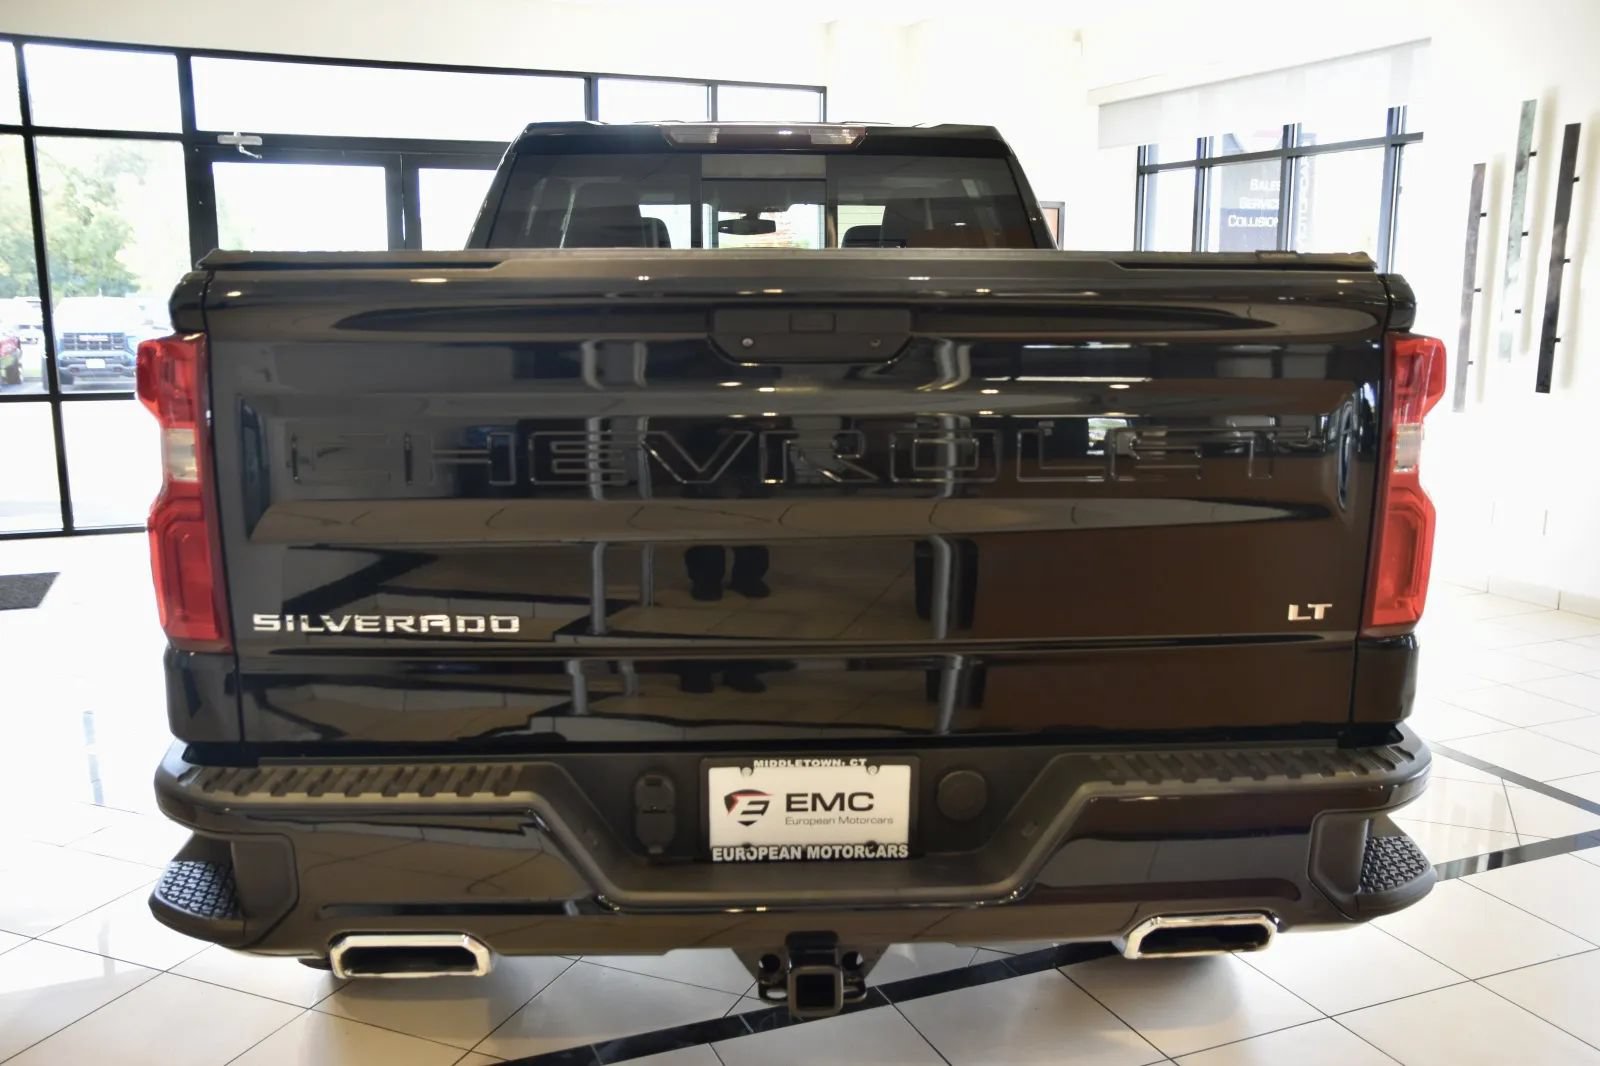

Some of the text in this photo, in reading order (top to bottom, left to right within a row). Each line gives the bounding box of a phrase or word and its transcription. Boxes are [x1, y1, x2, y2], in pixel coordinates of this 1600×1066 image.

[287, 424, 1310, 487] CHEVROLET
[1287, 603, 1333, 621] LT
[252, 613, 520, 633] SILVERADO
[849, 758, 867, 767] CT
[785, 792, 874, 812] EMC
[785, 816, 894, 826] European Motorcars
[712, 844, 909, 861] EUROPEAN MOTORCARS
